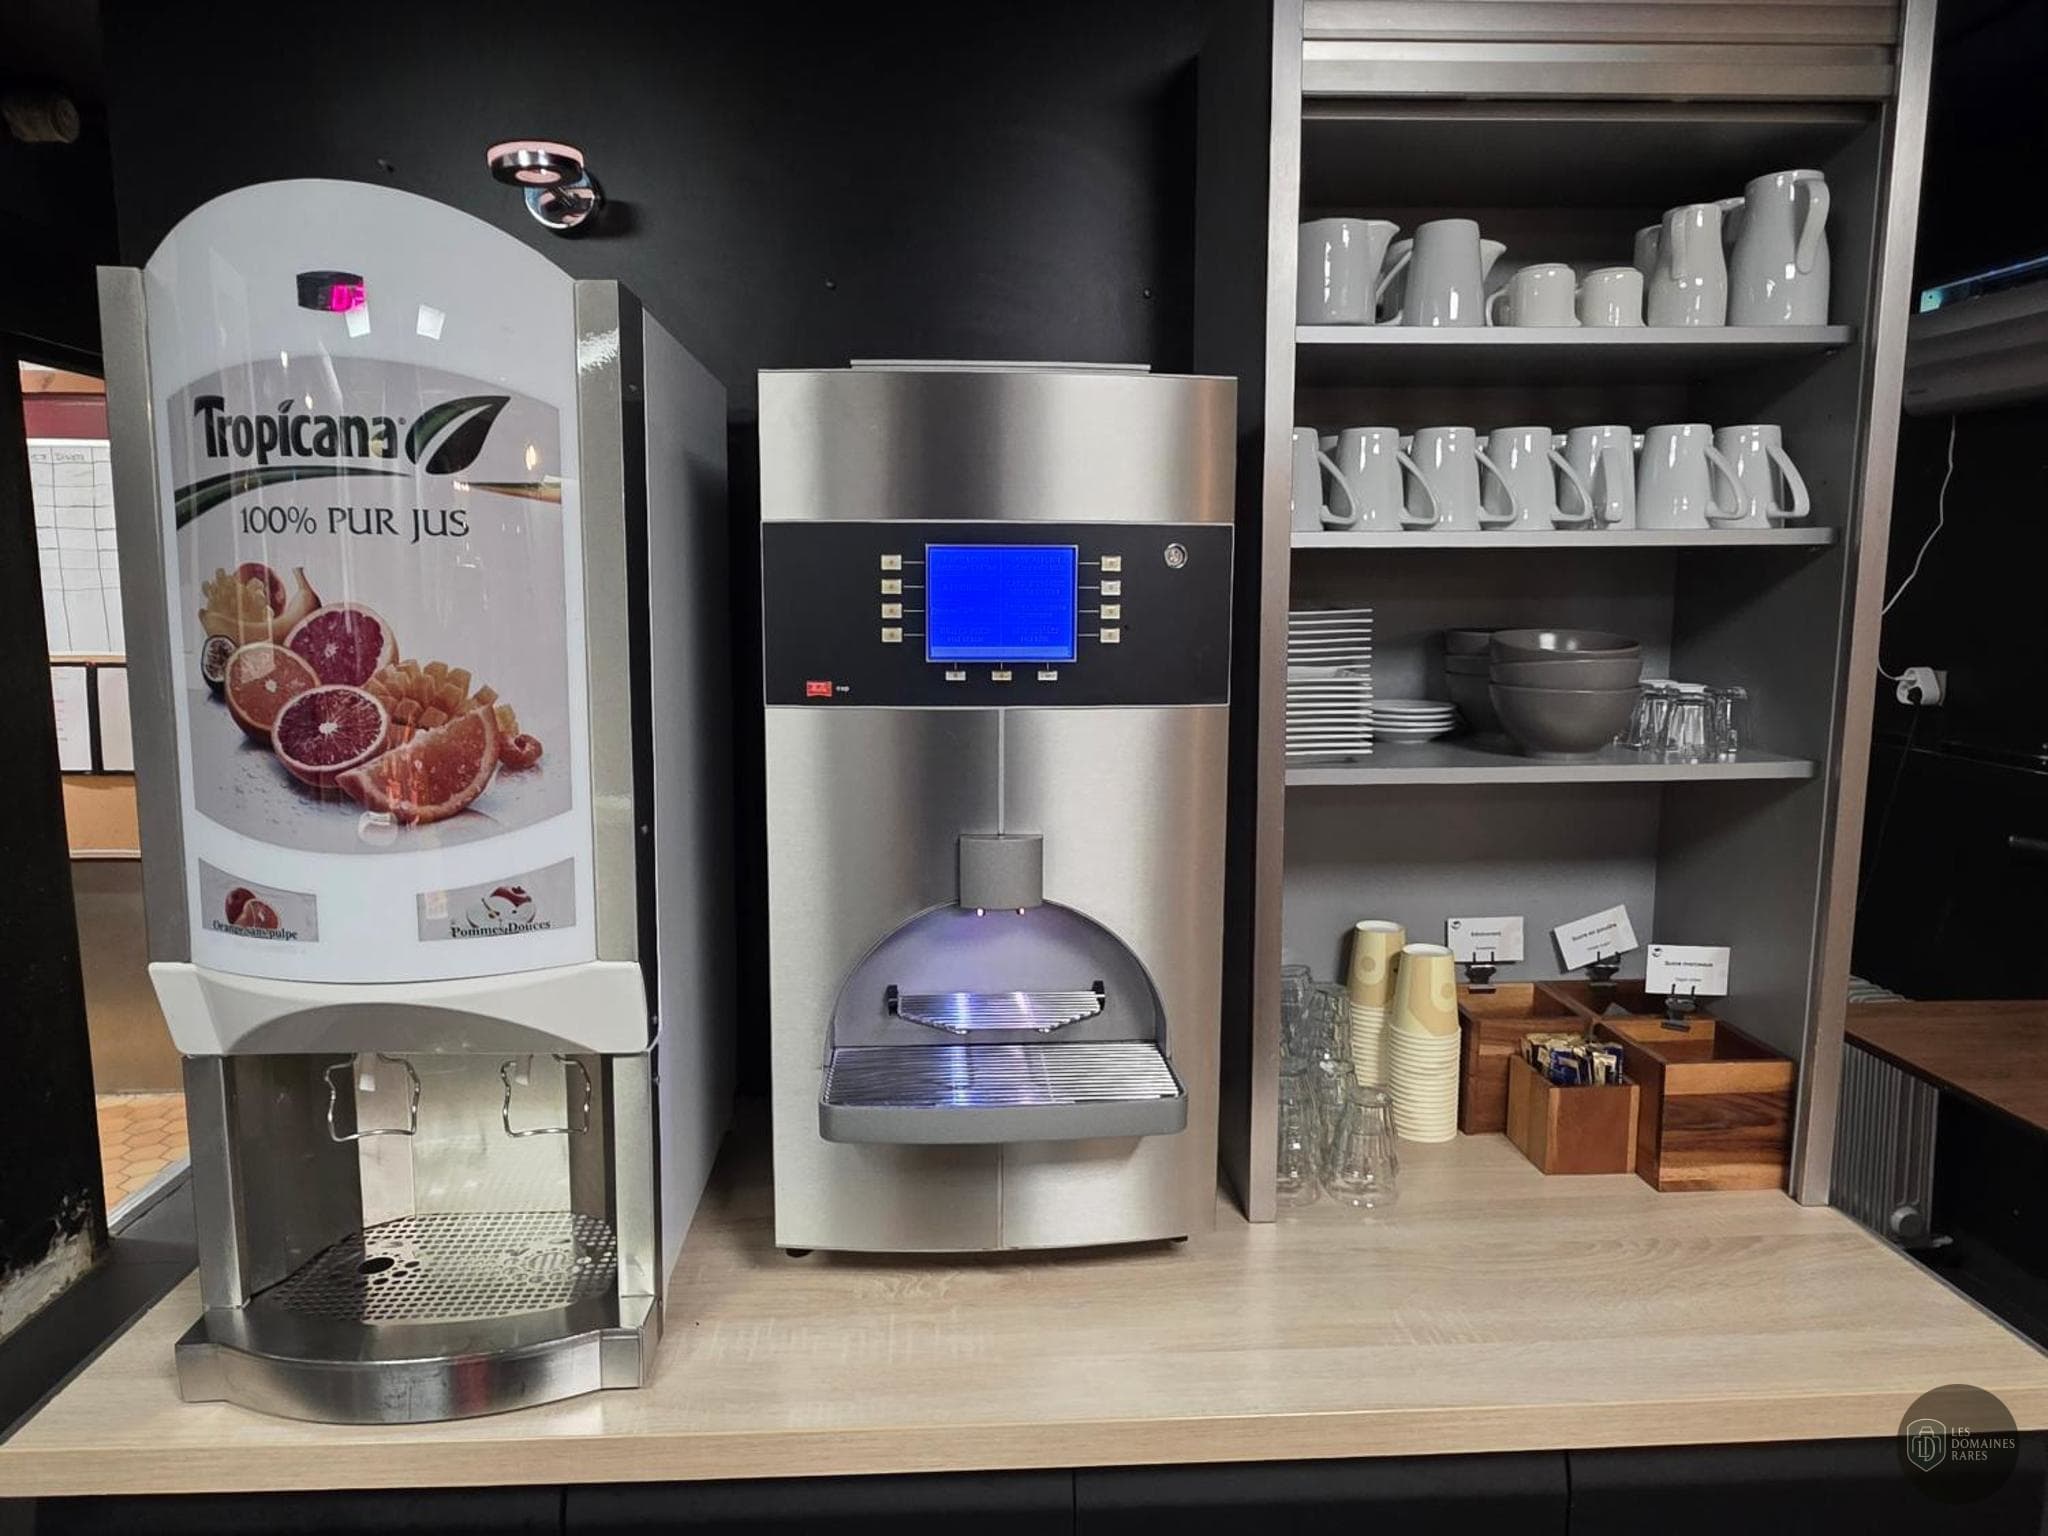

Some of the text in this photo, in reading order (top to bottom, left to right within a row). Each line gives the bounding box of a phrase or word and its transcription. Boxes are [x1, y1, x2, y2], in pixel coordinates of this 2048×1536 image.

[194, 395, 400, 465] Tropicana
[240, 506, 470, 544] 100% PUR JUS
[269, 927, 299, 941] pulpe
[450, 926, 505, 938] Pommes
